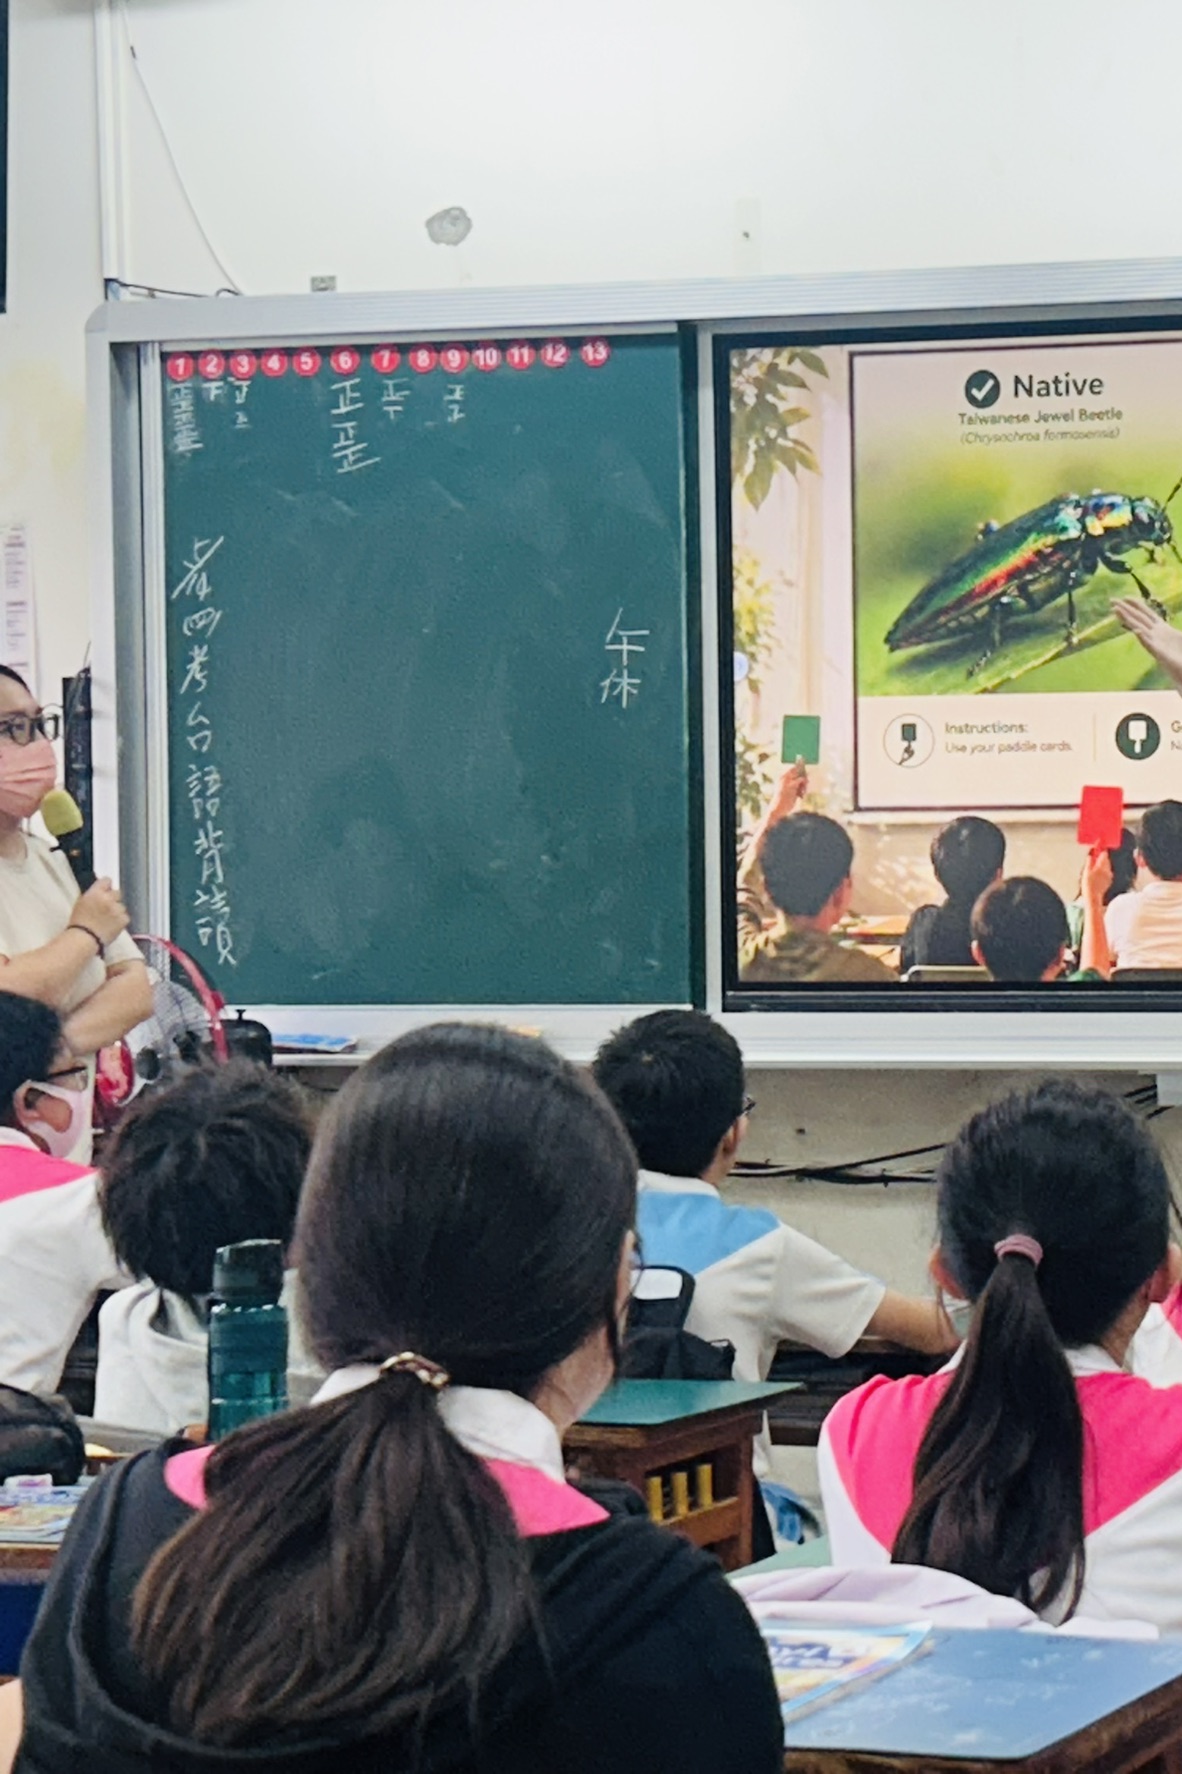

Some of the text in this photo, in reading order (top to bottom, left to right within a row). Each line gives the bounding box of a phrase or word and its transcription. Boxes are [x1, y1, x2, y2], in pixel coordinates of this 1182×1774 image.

[175, 342, 608, 375] 1 2 3 4 5 6 7 8 9 10 11 12 13
[1013, 371, 1104, 399] Native
[958, 406, 1123, 426] Taiwanese Jewel Beetle
[600, 607, 650, 709] 午休
[945, 721, 1028, 734] Instructions:
[945, 741, 968, 754] Use
[970, 743, 995, 756] your
